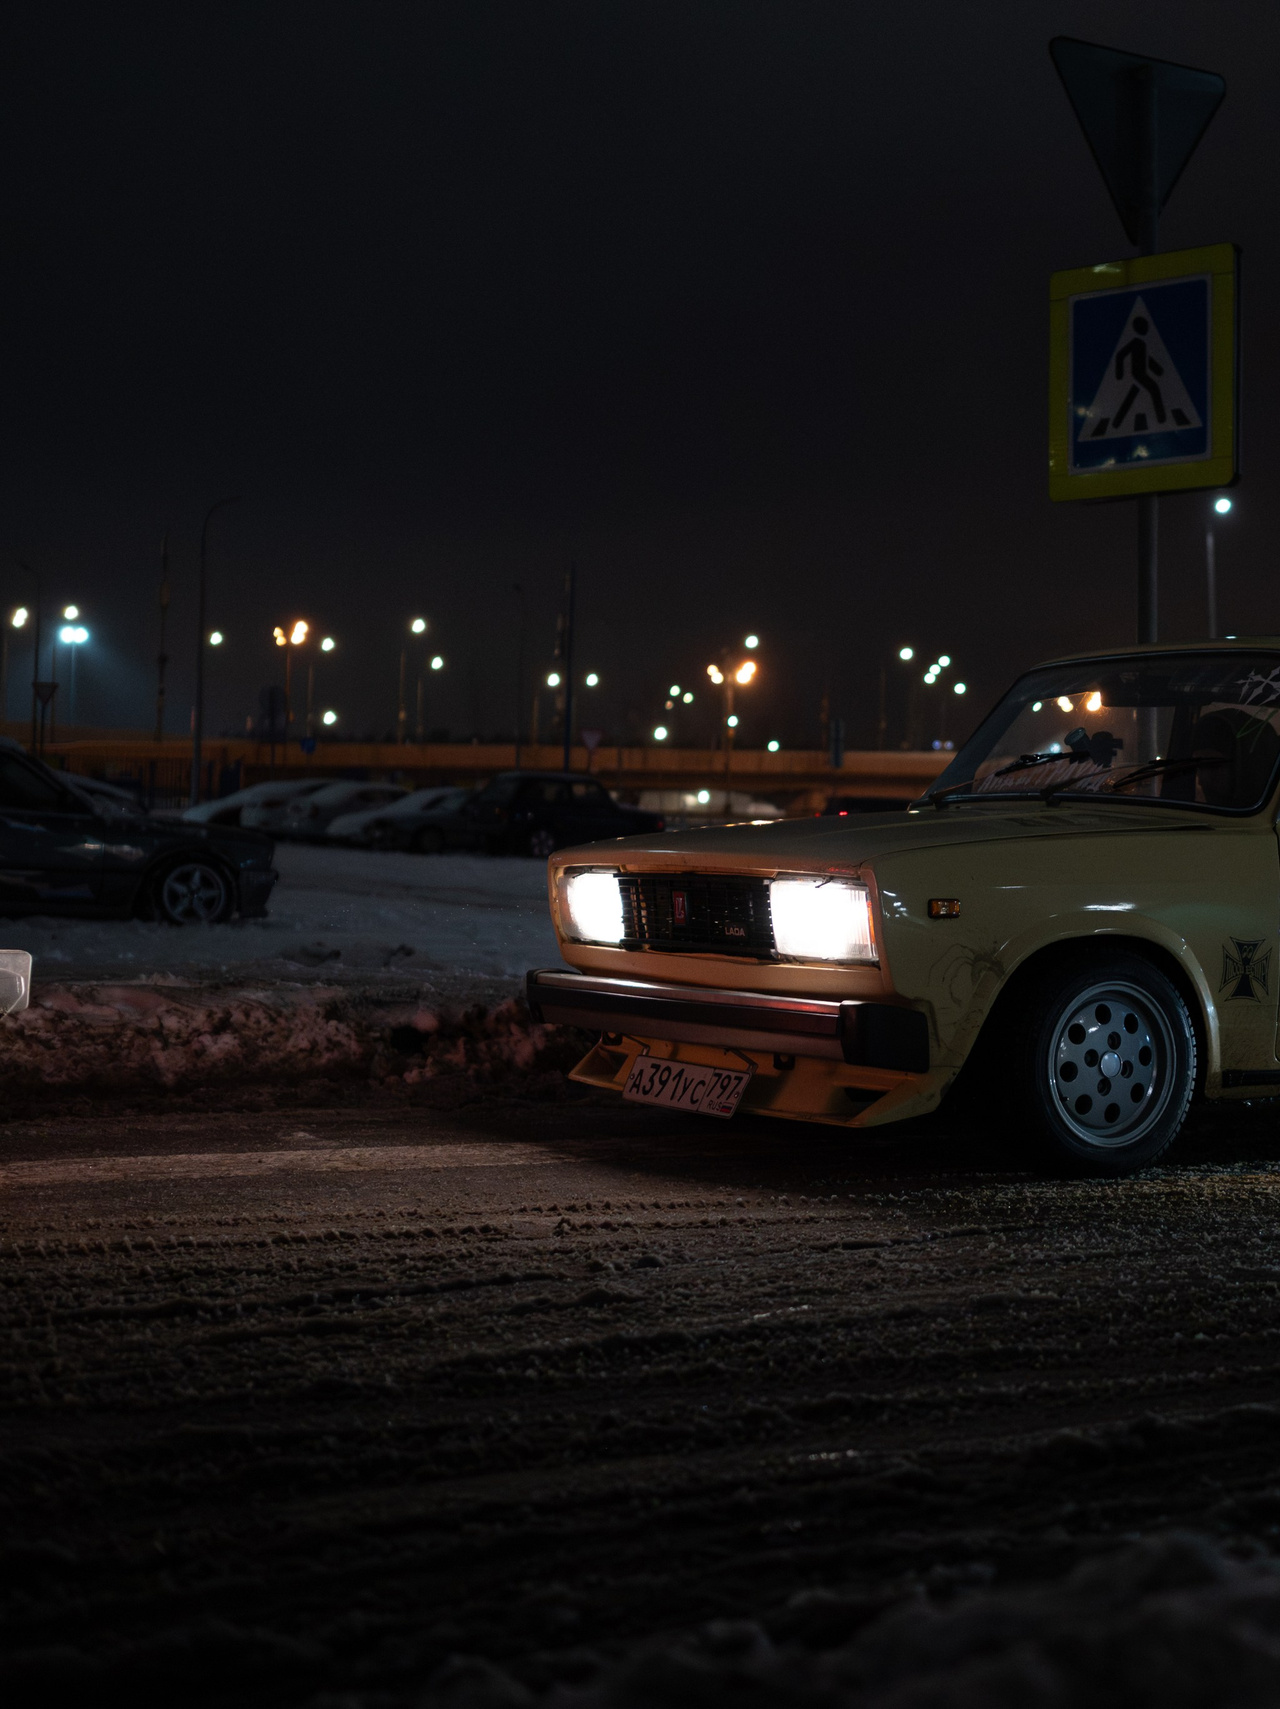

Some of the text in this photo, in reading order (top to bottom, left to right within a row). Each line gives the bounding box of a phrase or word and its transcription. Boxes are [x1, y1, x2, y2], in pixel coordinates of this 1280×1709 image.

[724, 926, 746, 938] LADA
[629, 1063, 743, 1105] А391УС 797
[707, 1099, 722, 1111] RUS
